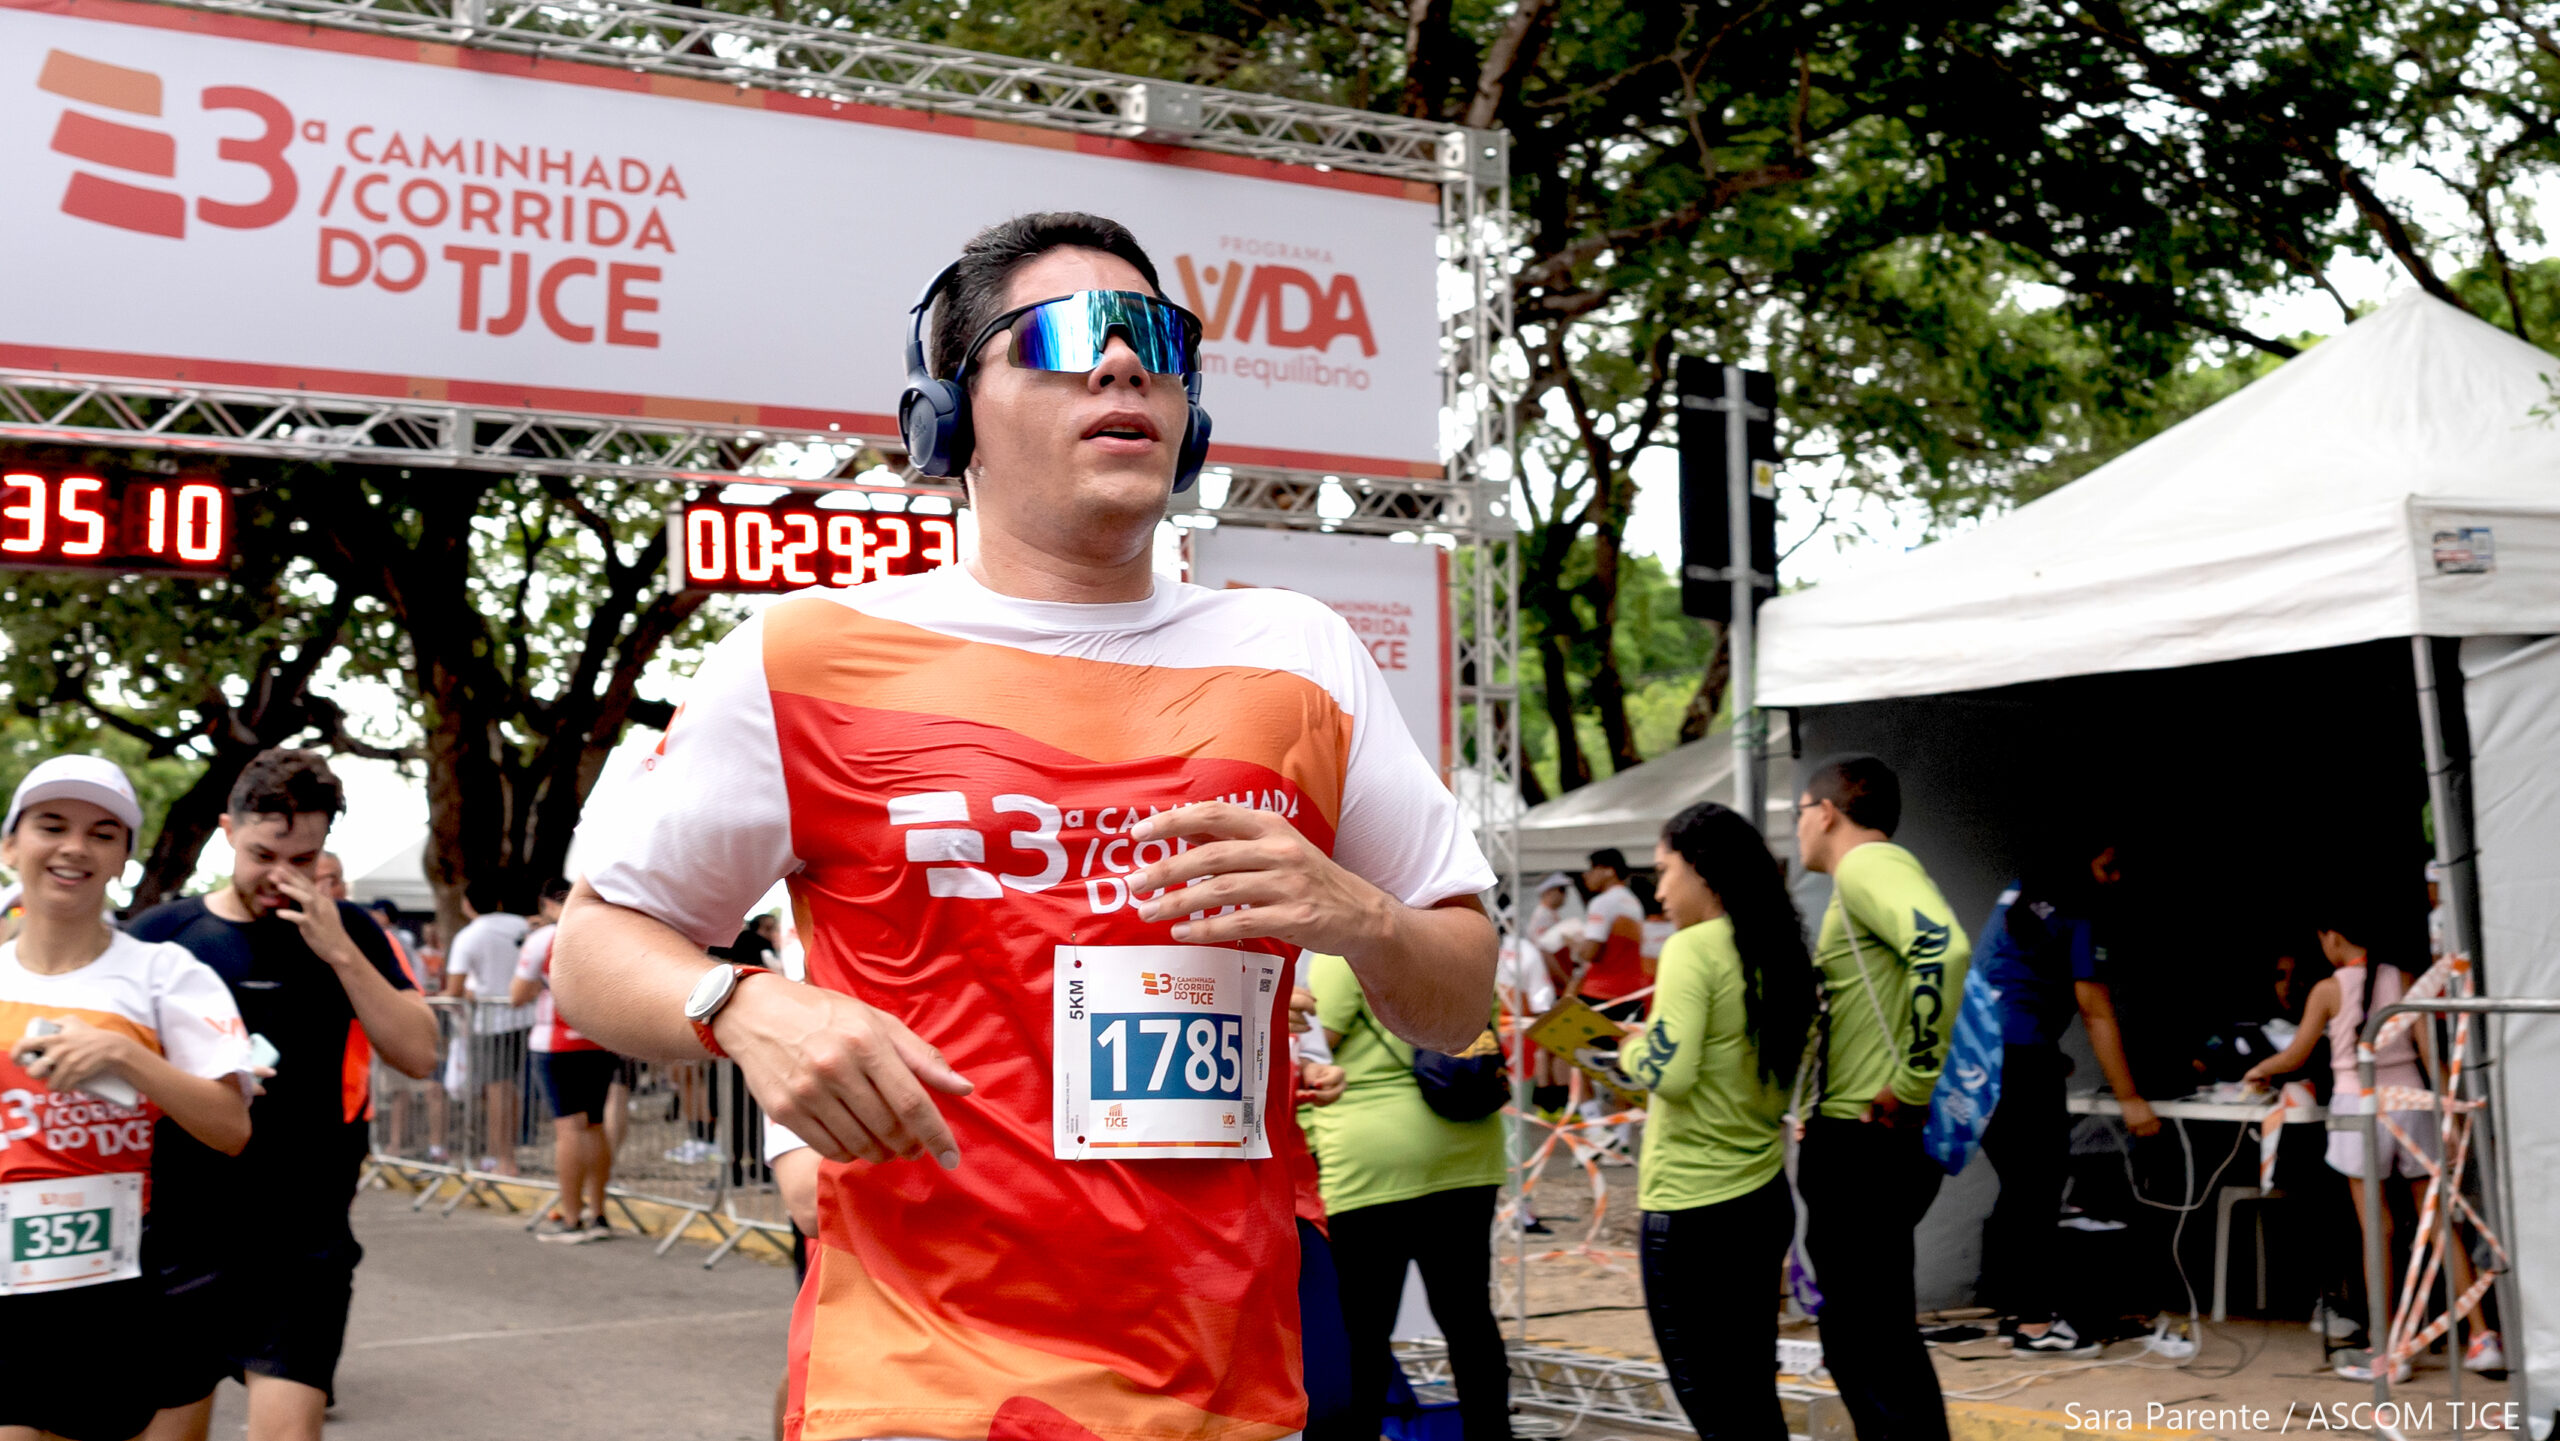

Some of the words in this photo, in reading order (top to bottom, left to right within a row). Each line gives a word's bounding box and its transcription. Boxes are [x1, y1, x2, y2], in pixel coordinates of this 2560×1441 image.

[196, 84, 328, 232] 3ª
[345, 125, 687, 200] CAMINHADA
[318, 164, 677, 254] /CORRIDA
[1219, 236, 1334, 264] PROGRAMA
[317, 226, 428, 294] DO
[443, 244, 663, 350] TJCE
[687, 509, 955, 586] 00:29:23
[1362, 639, 1408, 669] CE
[1173, 983, 1215, 993] /CORRIDA
[1176, 976, 1216, 984] CAMINHADA
[1069, 980, 1084, 1020] 5KM
[1174, 991, 1188, 1000] DO
[1188, 992, 1214, 1005] TJCE
[1096, 1018, 1241, 1093] 1785
[46, 1126, 89, 1150] DO
[1104, 1117, 1128, 1128] TJCE
[24, 1211, 101, 1258] 352
